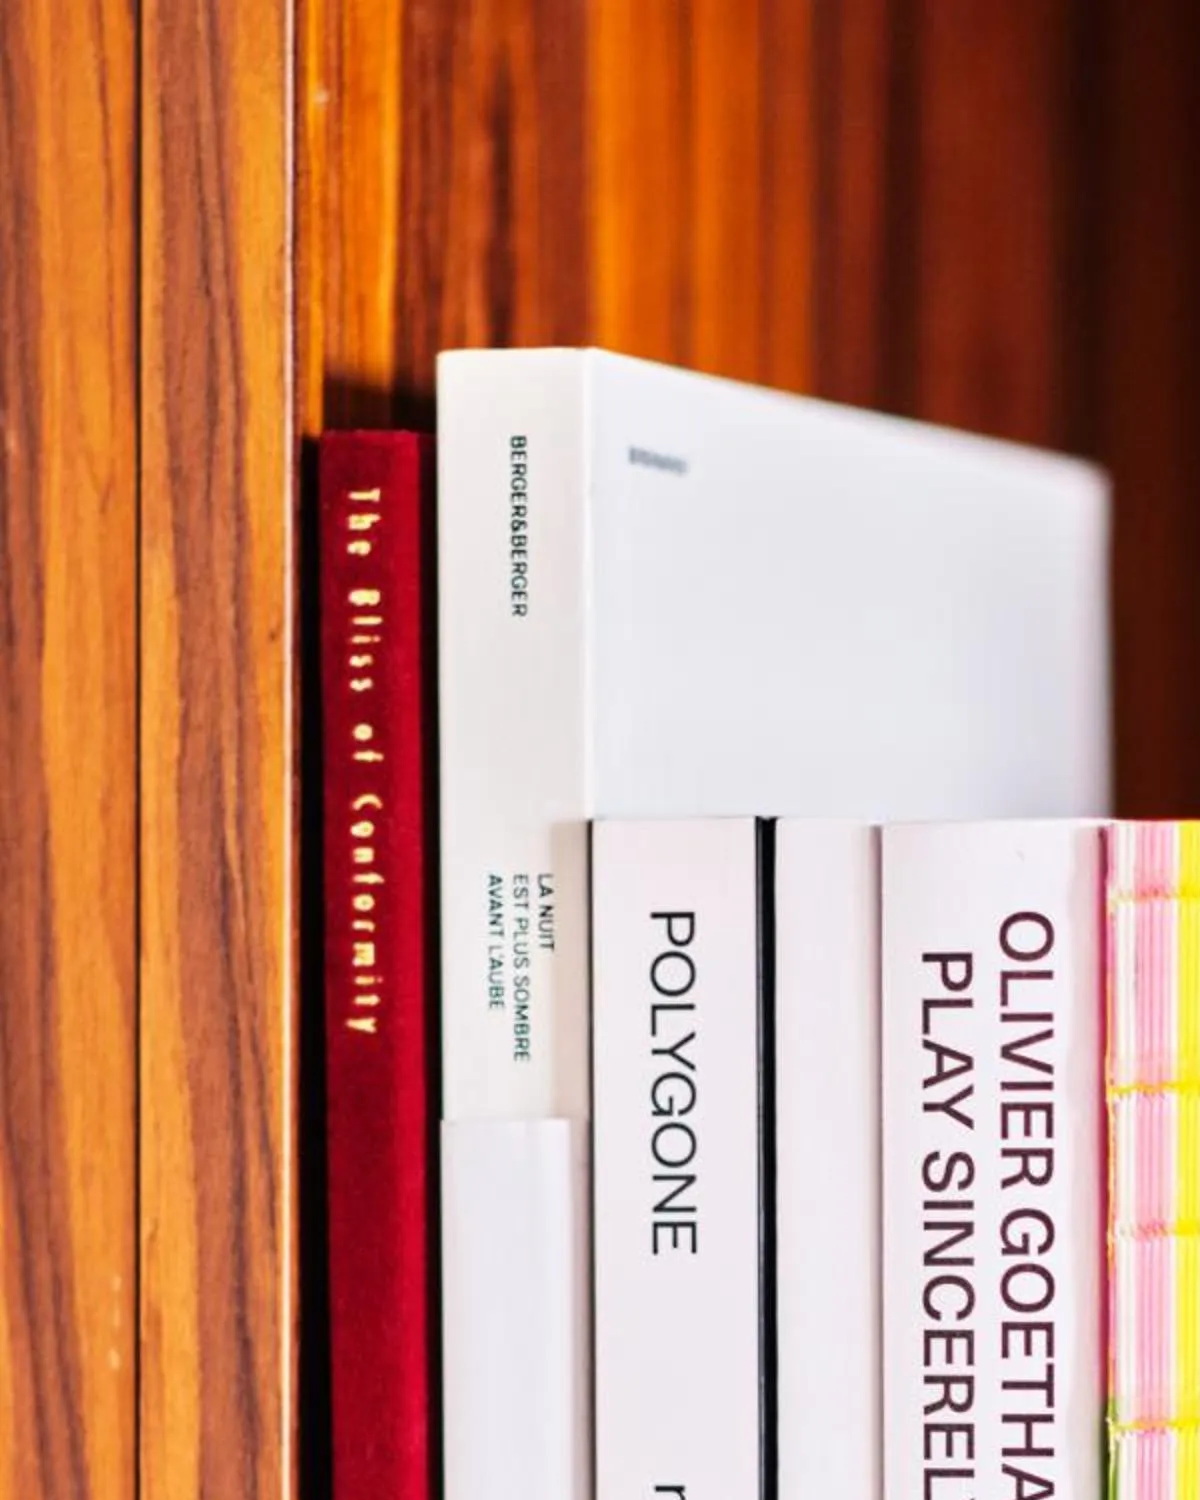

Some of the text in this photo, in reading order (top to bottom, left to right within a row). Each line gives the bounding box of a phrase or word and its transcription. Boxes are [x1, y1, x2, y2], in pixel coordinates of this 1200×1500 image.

[509, 435, 528, 617] BERGER&BERGER
[347, 487, 384, 1035] The Bliss of Conformity
[488, 874, 504, 937] AVANT
[513, 874, 530, 1062] EST PLUS SOMBRE
[538, 873, 555, 951] LA NUIT
[650, 912, 696, 1255] POLYGONE
[922, 953, 973, 1129] PLAY
[1000, 912, 1054, 1189] OLIVIER
